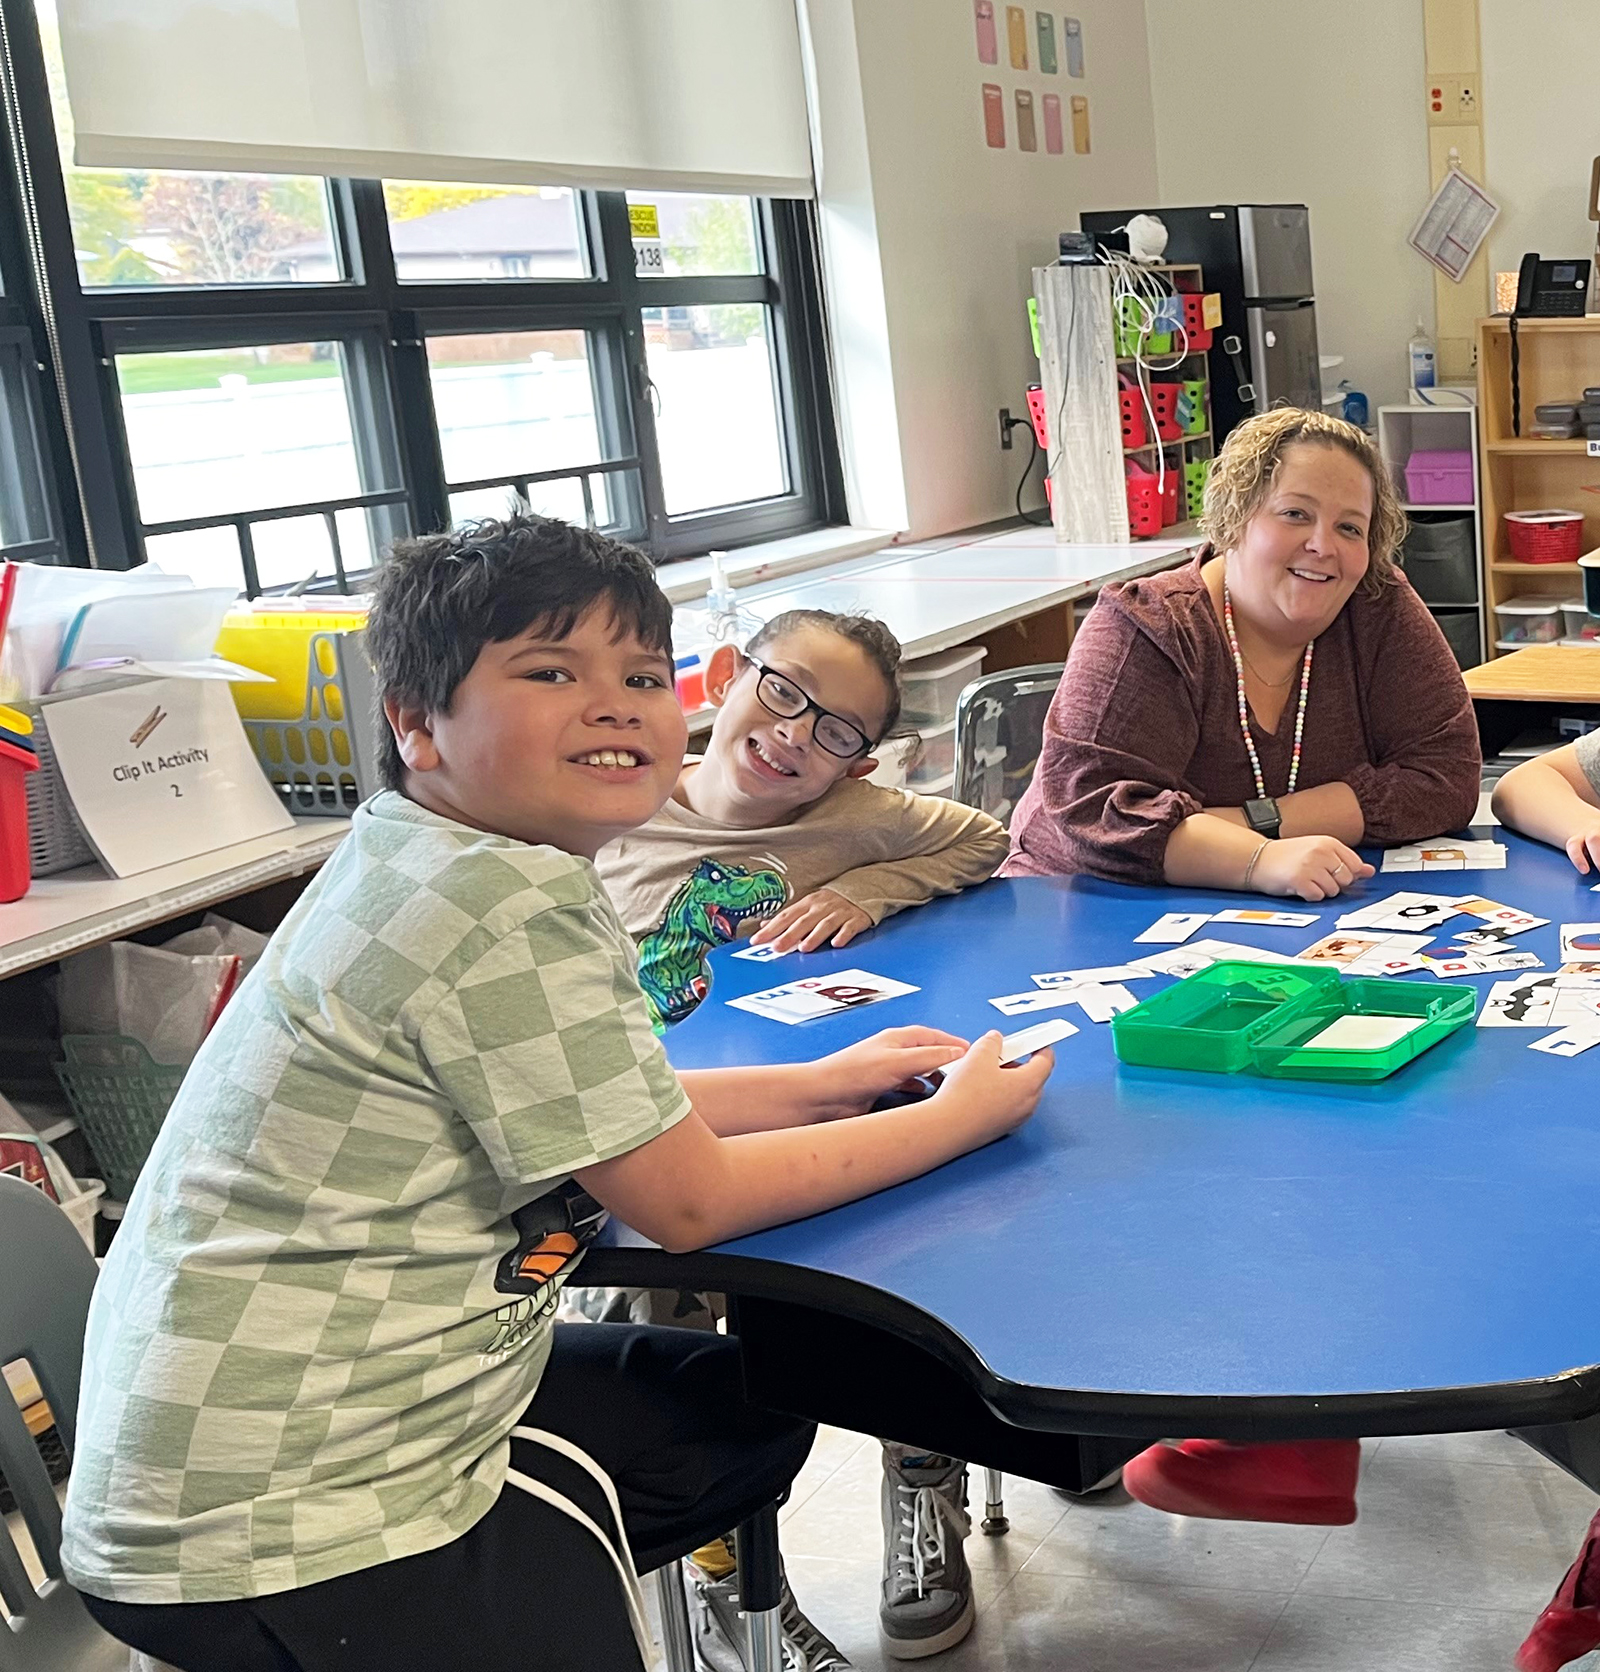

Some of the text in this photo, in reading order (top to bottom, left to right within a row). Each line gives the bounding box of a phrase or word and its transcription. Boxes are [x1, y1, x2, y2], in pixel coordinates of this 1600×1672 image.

[113, 747, 209, 782] Clip It Activity
[170, 784, 183, 798] 2
